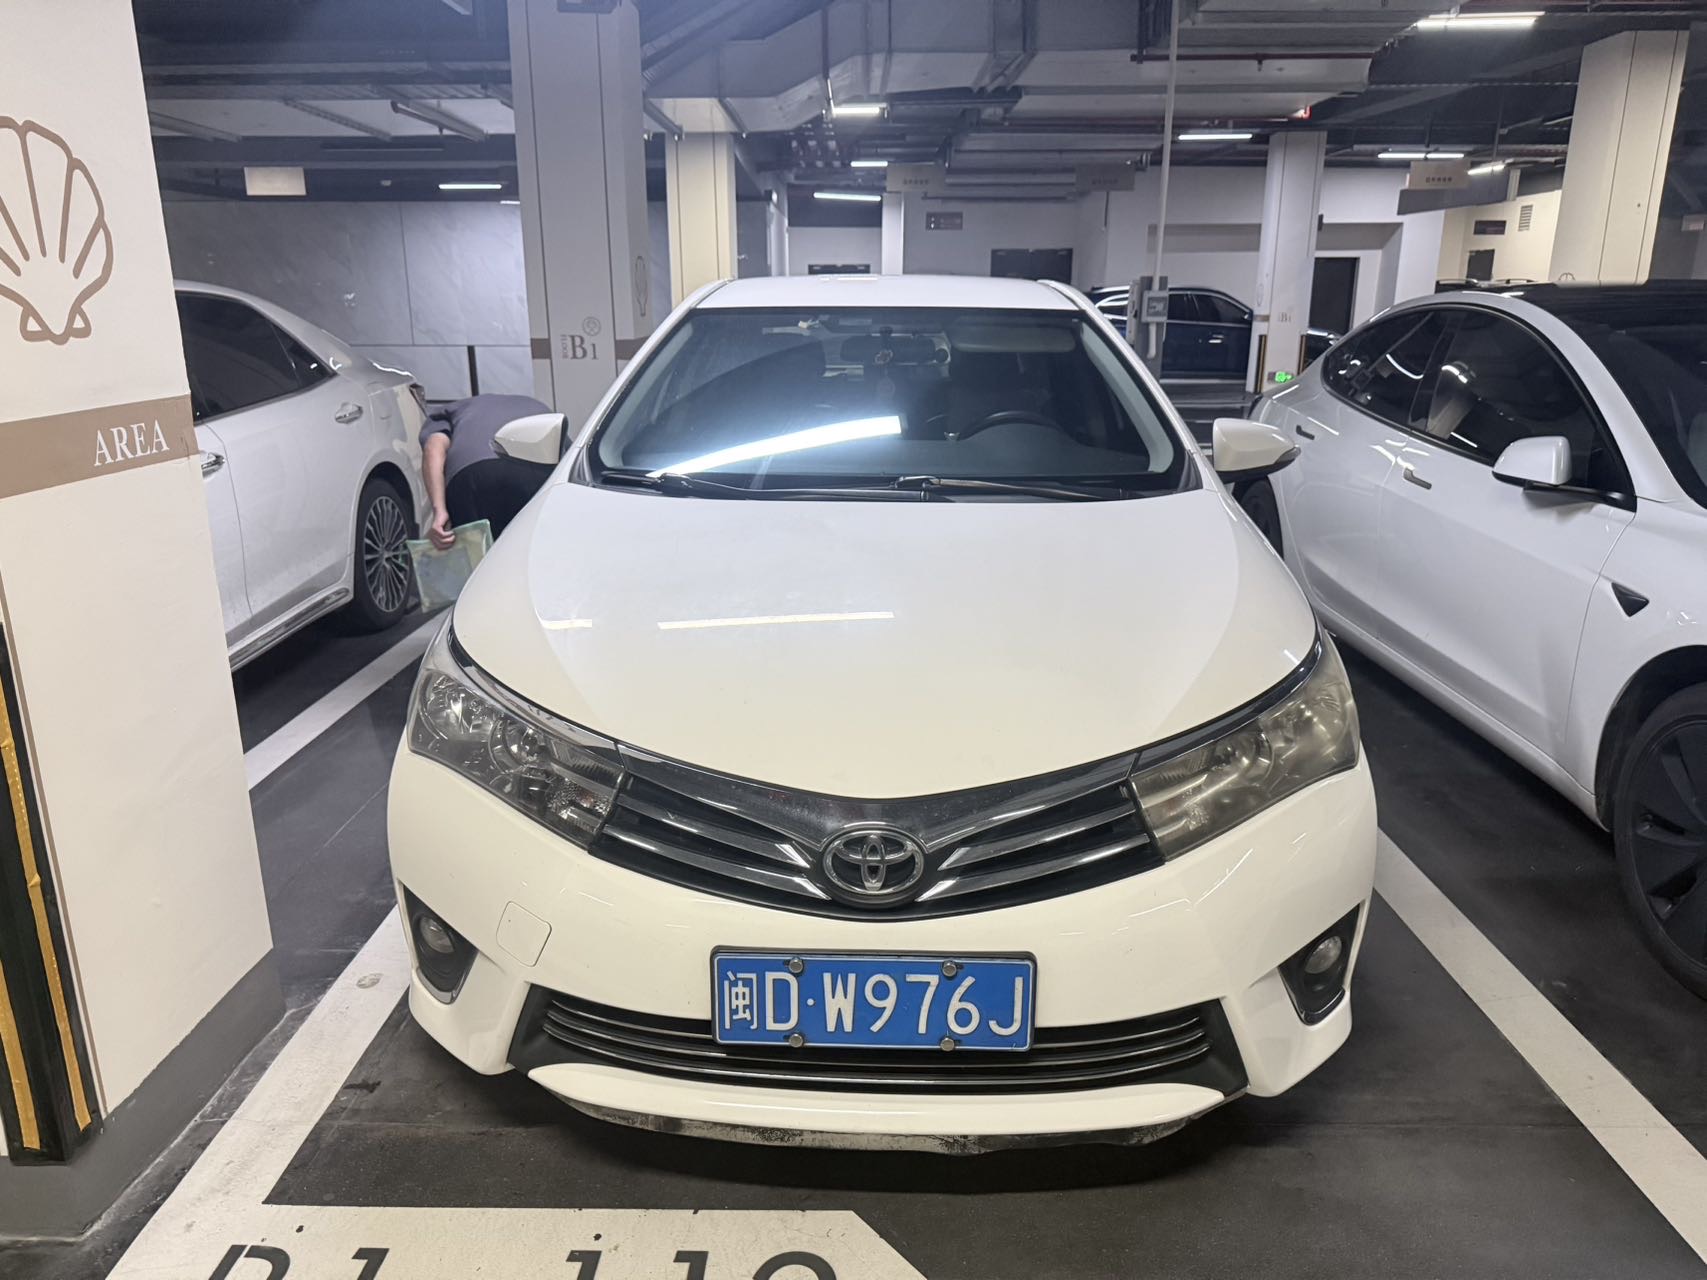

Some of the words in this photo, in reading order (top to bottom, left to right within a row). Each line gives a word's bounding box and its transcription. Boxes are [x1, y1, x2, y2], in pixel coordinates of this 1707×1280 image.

[568, 334, 599, 360] B1
[93, 419, 170, 467] AREA
[723, 970, 1024, 1037] 闽D·W976J
